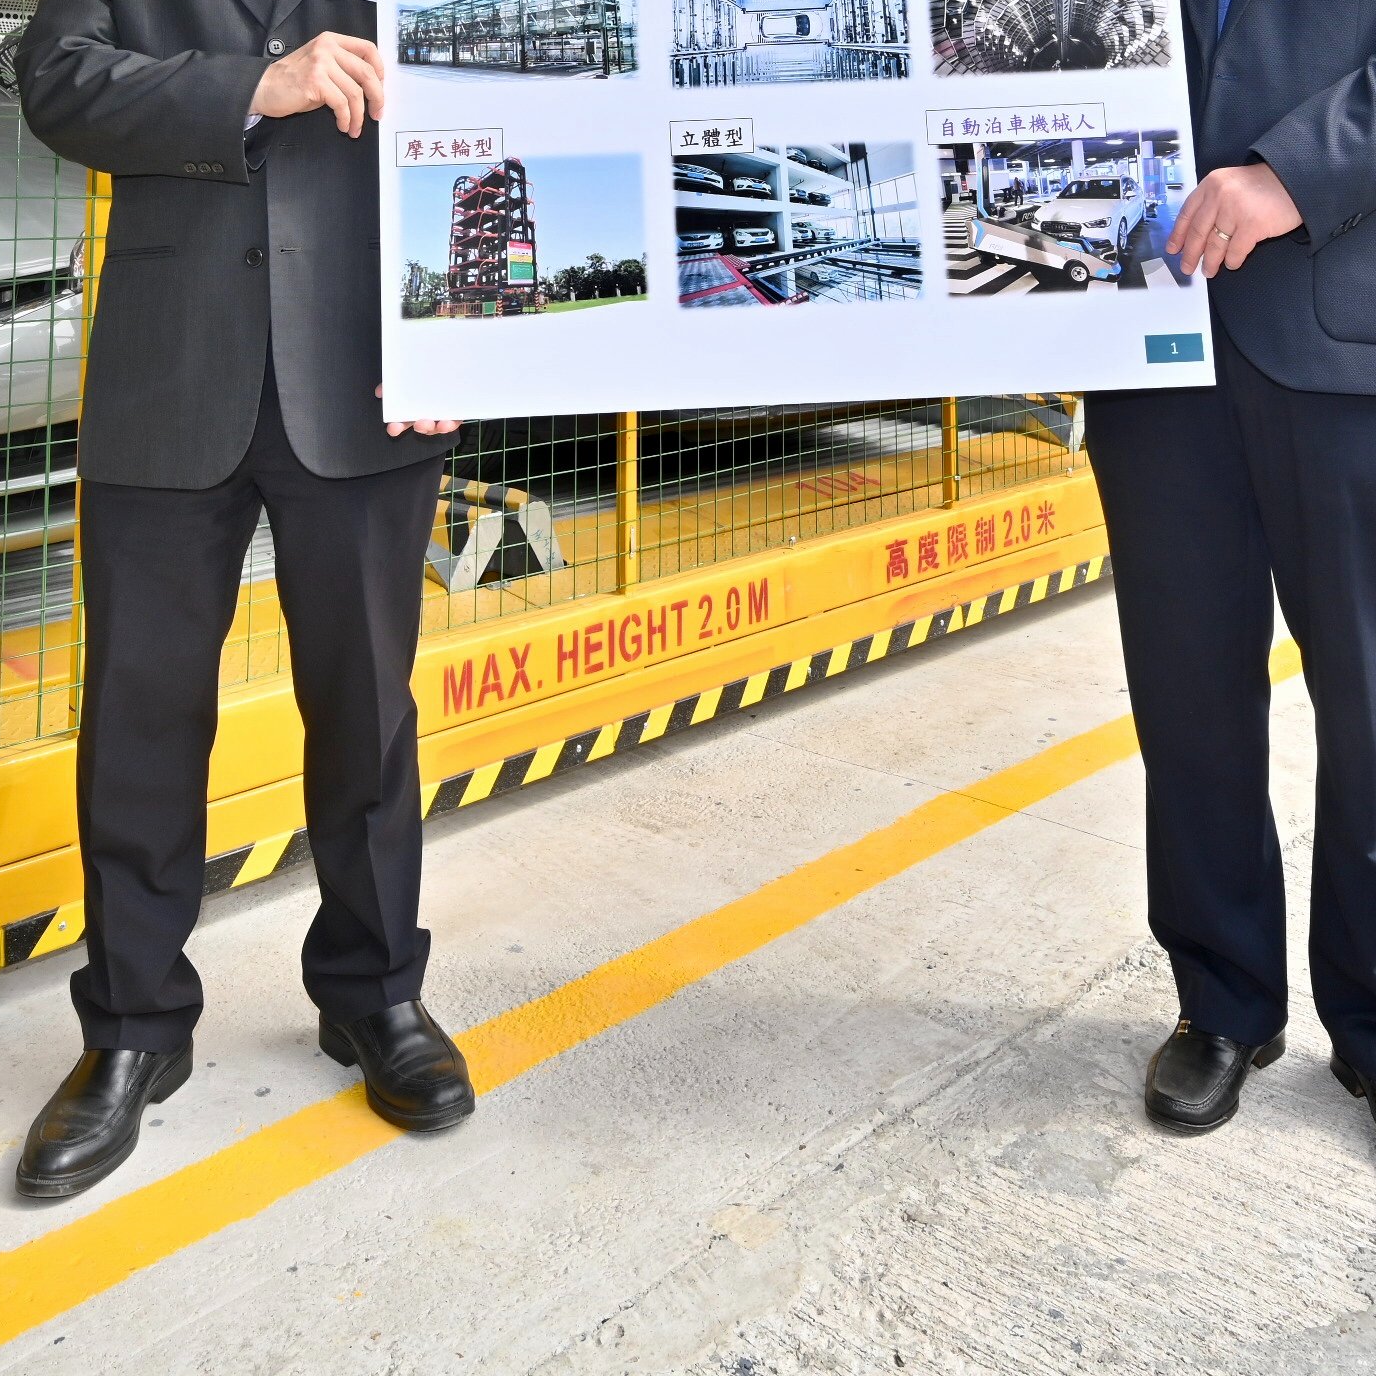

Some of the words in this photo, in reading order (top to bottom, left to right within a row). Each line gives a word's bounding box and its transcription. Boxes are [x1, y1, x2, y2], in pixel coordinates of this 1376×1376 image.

[941, 113, 1095, 137] 自動泊車機械人
[404, 137, 493, 161] 摩天輪型
[680, 127, 744, 148] 立體型
[1170, 340, 1179, 356] 1
[442, 644, 544, 716] MAX.
[557, 601, 688, 684] HEIGHT
